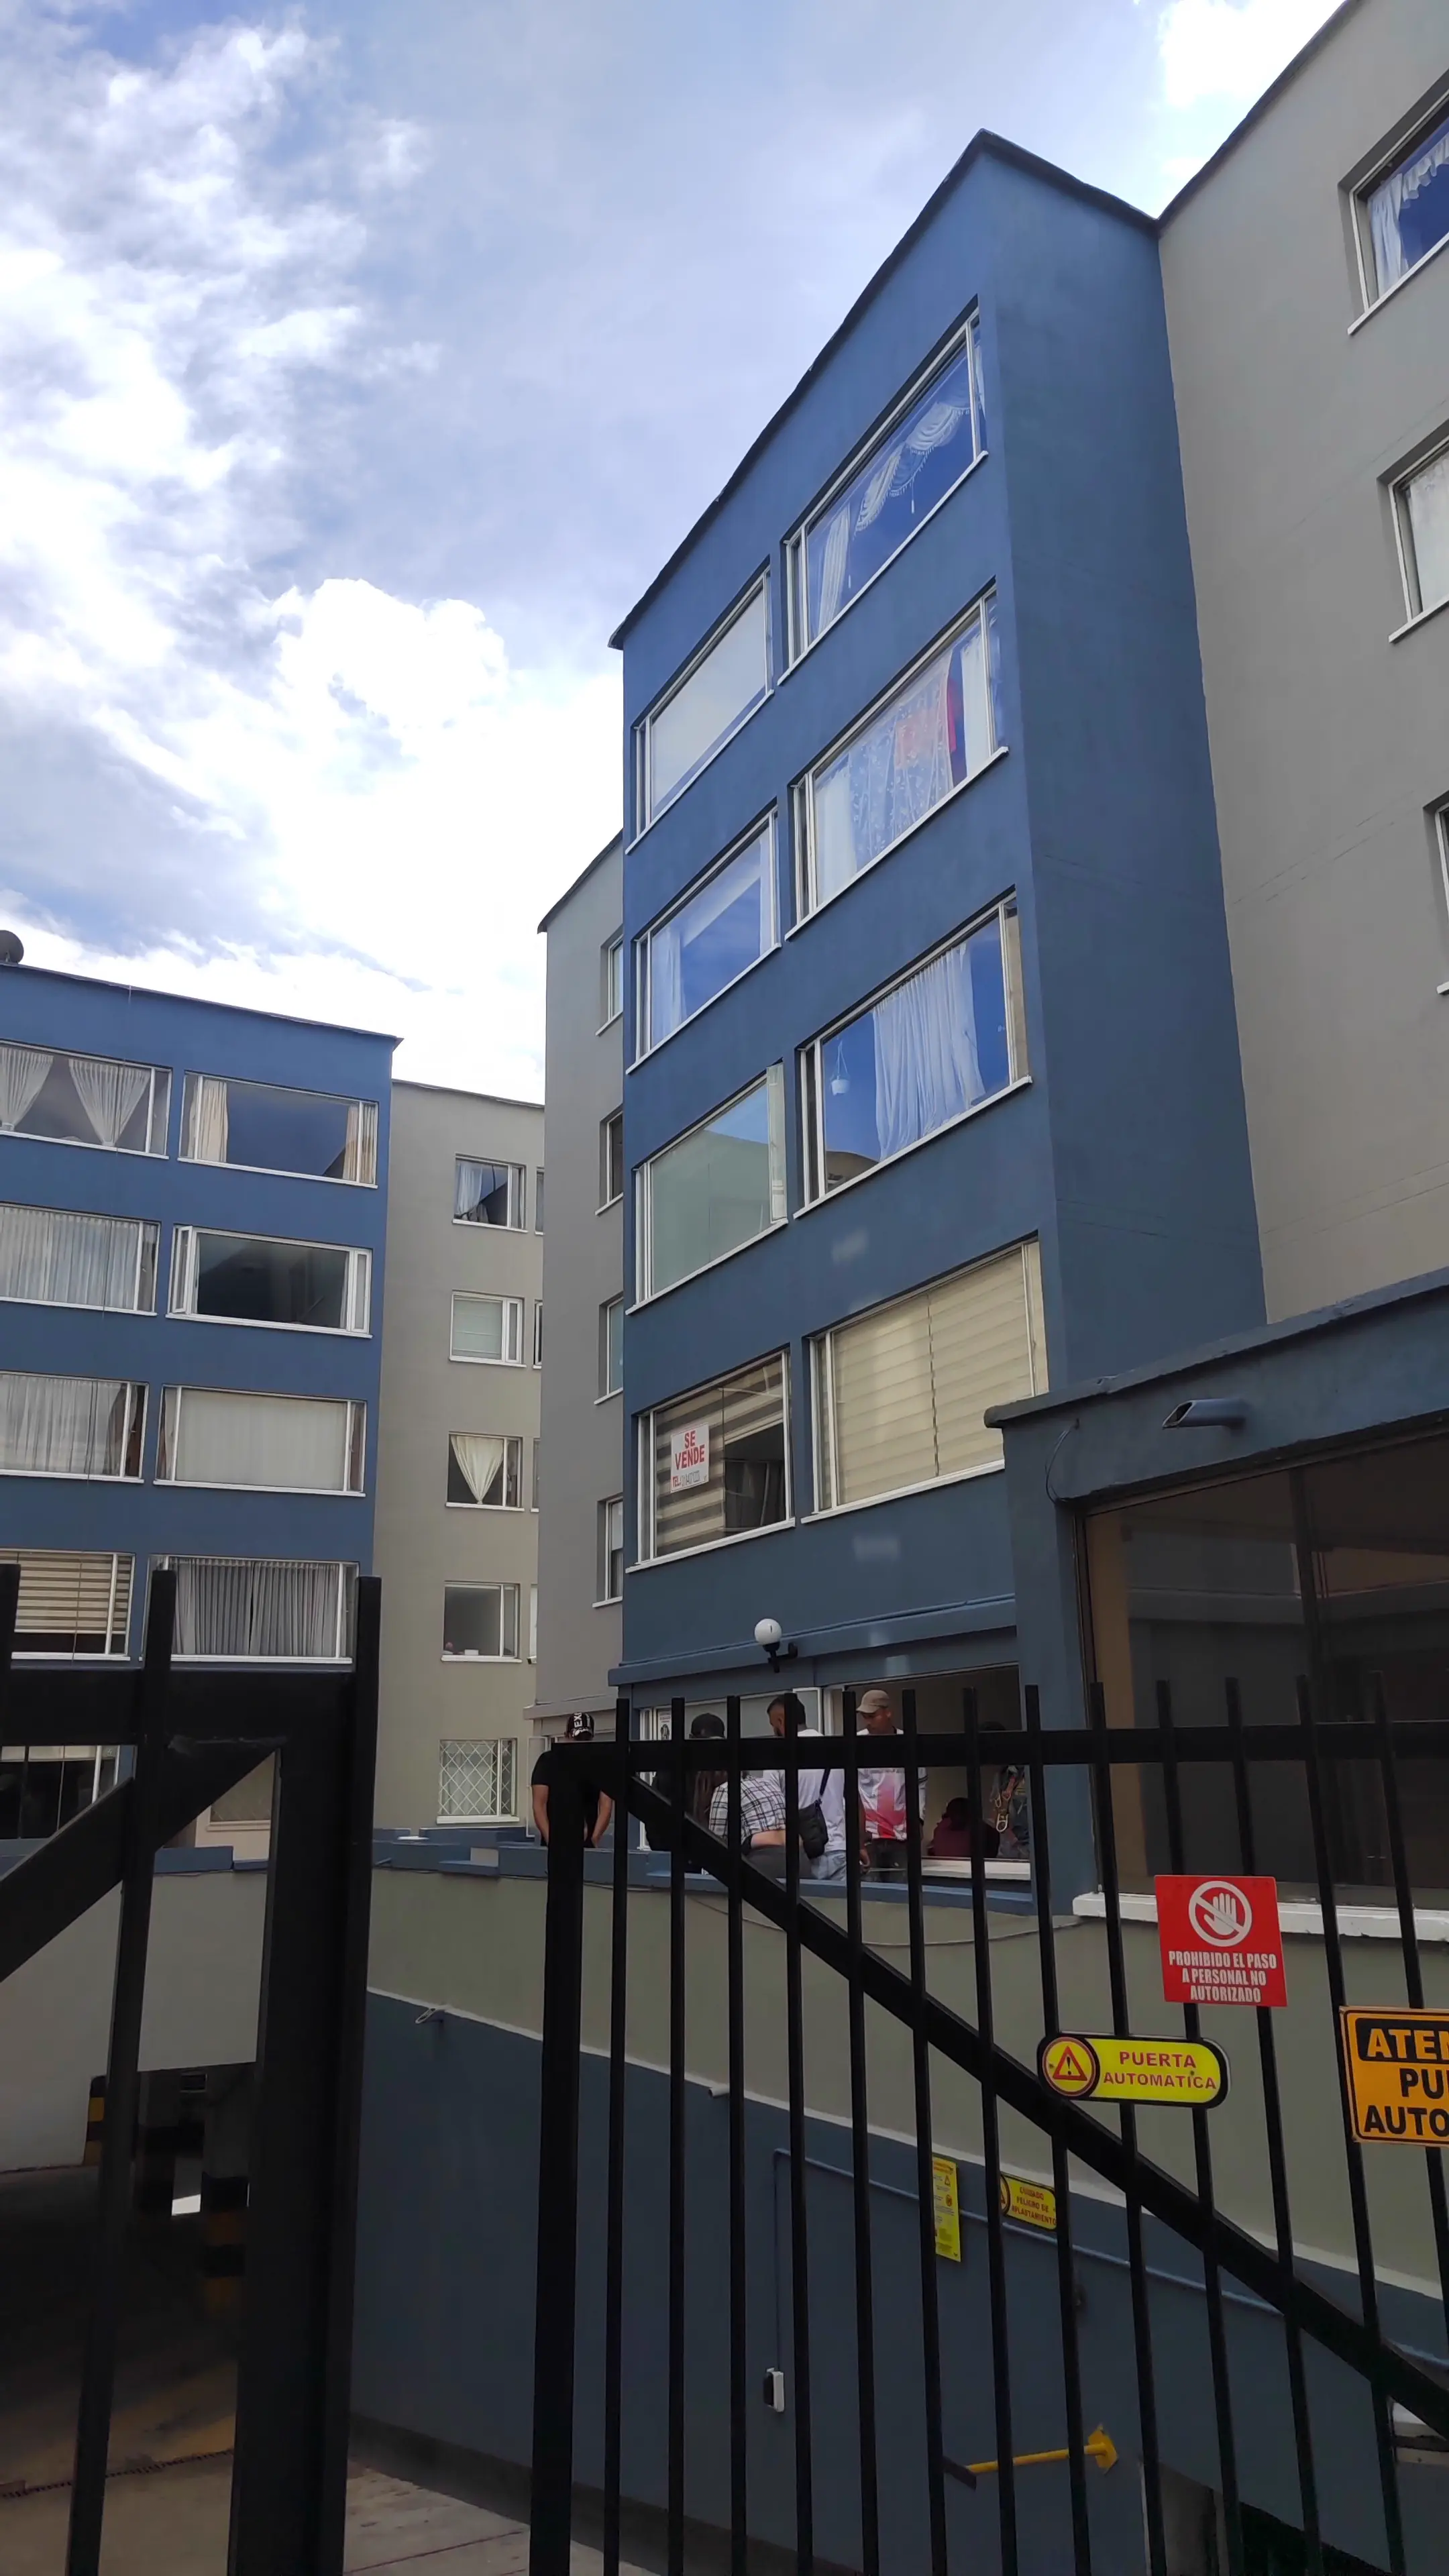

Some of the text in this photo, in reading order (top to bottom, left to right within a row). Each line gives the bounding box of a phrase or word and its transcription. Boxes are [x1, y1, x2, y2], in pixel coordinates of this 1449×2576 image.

[684, 1430, 696, 1449] SE
[675, 1444, 705, 1470] VENDE
[1169, 1951, 1277, 1969] PROHIBIDO EL PASO
[1182, 1968, 1267, 1986] A PERSONAL NO
[1190, 1986, 1261, 2003] AUTORIZADO
[1119, 2051, 1197, 2069] PUERTA
[1104, 2072, 1216, 2090] AUTOMATICA
[1399, 2068, 1449, 2100] PU
[1364, 2105, 1449, 2137] AUTO
